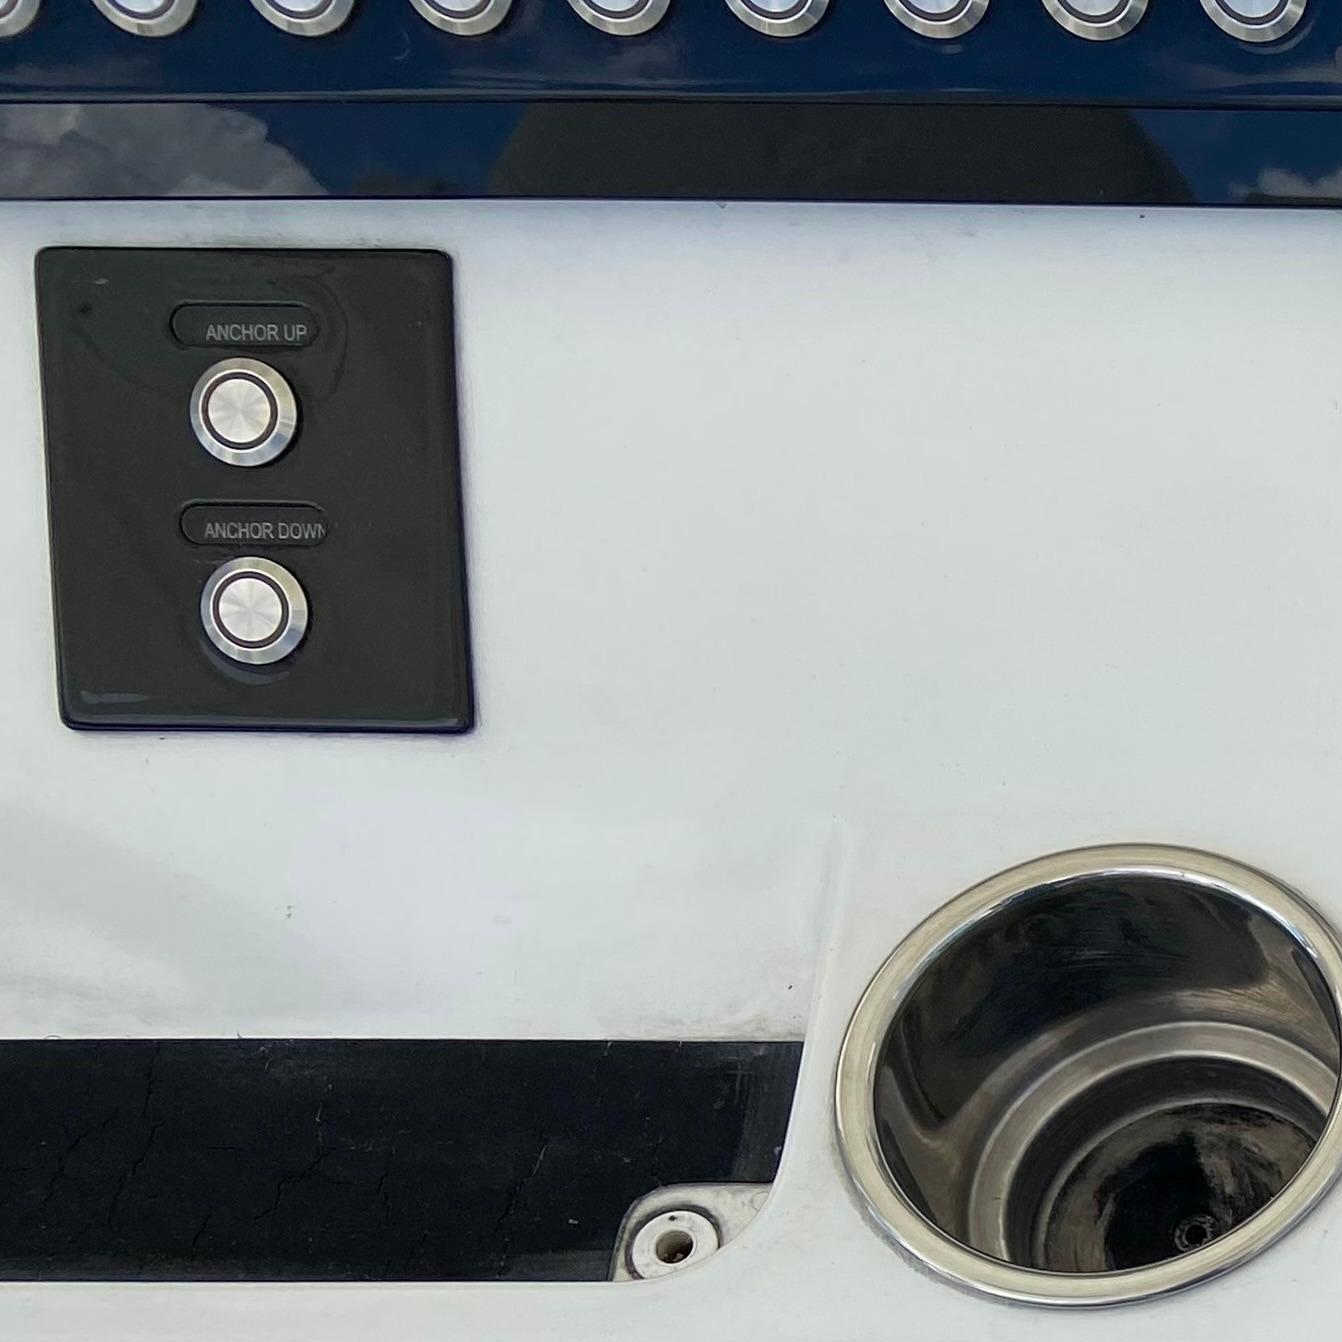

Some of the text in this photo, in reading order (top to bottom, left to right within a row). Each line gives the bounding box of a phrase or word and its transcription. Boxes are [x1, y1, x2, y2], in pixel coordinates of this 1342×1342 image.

[205, 323, 308, 342] ANCHOR UP
[204, 522, 326, 540] ANCHOR DOWN
